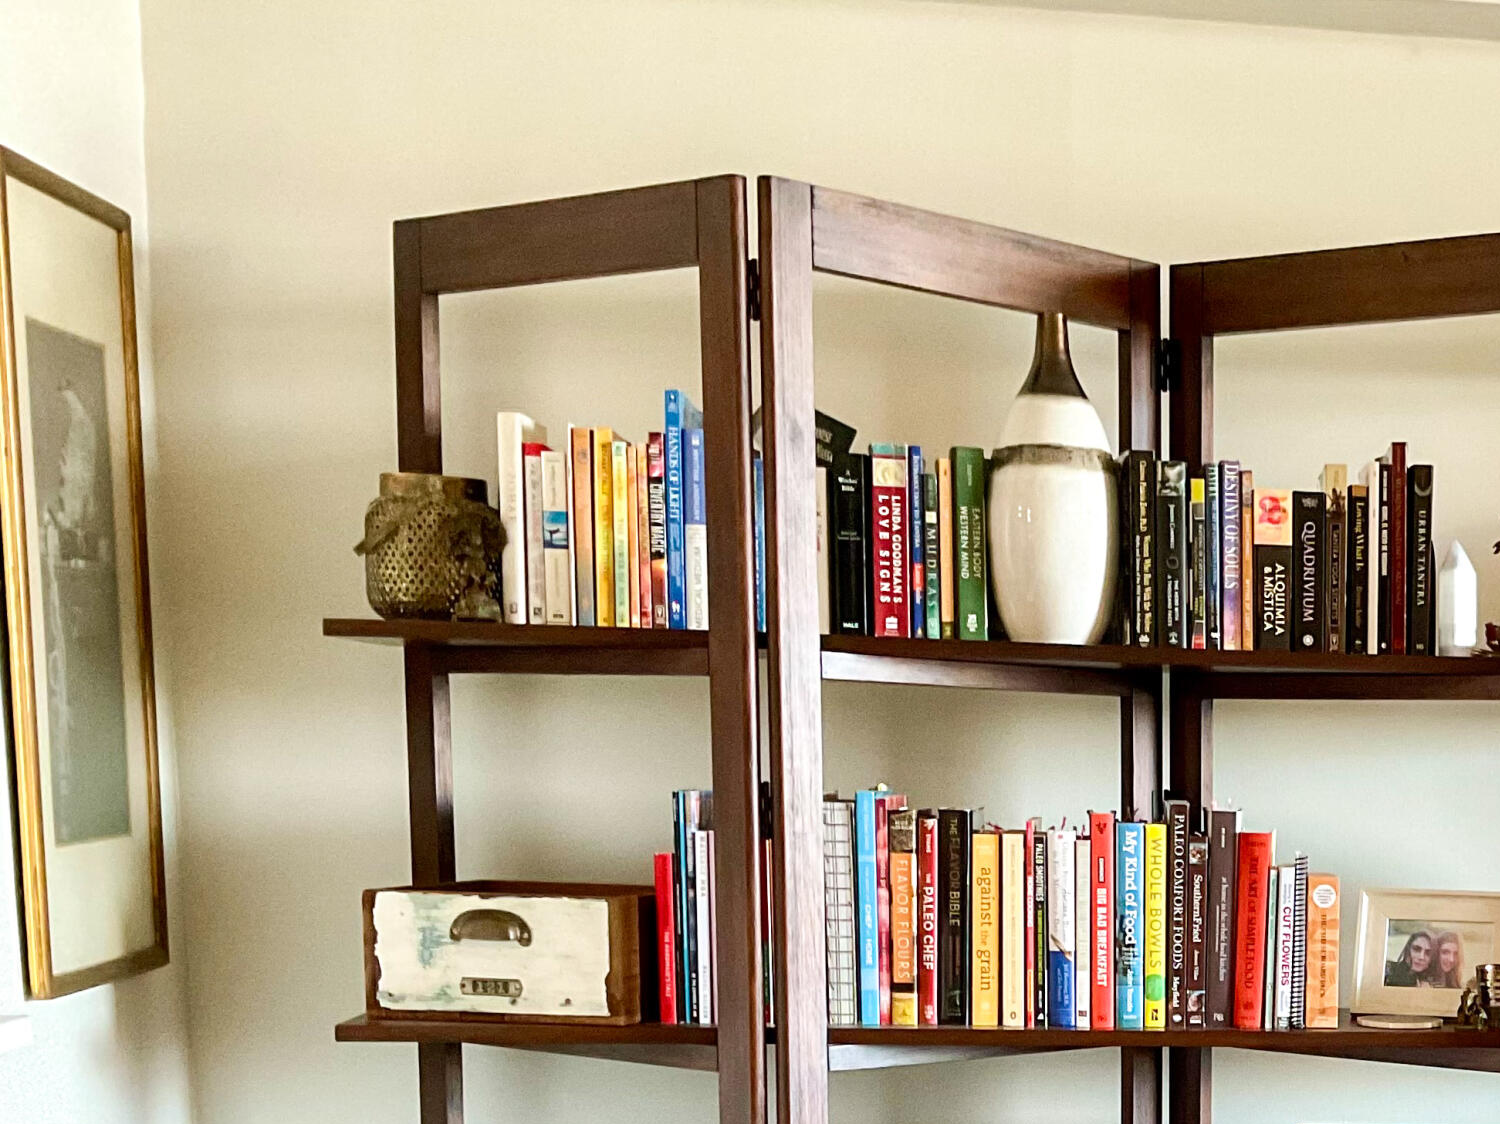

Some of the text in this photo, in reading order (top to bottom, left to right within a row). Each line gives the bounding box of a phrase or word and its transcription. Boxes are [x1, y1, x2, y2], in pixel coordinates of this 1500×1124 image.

[668, 426, 681, 468] HANDS
[669, 470, 681, 485] OF
[669, 487, 681, 522] LIGHT
[650, 483, 665, 553] COVENTRY MAGIC
[891, 495, 901, 531] LINDA
[1224, 463, 1240, 589] DESTINY OF SOULS
[1354, 502, 1365, 572] Loving What Is
[878, 494, 891, 604] LOVE SIGNS
[926, 527, 937, 609] MUDRAS
[959, 506, 970, 580] WESTERN MIND
[972, 507, 982, 578] EASTERN BODY
[1416, 510, 1426, 606] URBAN TANTRA
[1273, 562, 1286, 635] ALQUIMIA
[1301, 521, 1316, 622] QUADRIVIUM
[695, 587, 704, 629] MEDICAL
[1263, 576, 1275, 632] MÍSTICA
[949, 818, 958, 835] THE
[1035, 843, 1044, 864] PALEO
[1174, 814, 1186, 856] PALEO
[949, 837, 960, 890] FLAVOR
[1035, 865, 1044, 902] SMOOTHIES
[1122, 830, 1138, 945] My Kind of Food
[1172, 859, 1185, 922] COMFORT
[864, 904, 873, 928] CHEF
[896, 860, 911, 979] FLAVOR FLOURS
[922, 886, 934, 931] PALEO
[949, 891, 960, 926] BIBLE
[1096, 887, 1107, 906] BIG
[1096, 906, 1107, 928] BAD
[1149, 838, 1162, 968] WHOLE BOWLS
[1245, 857, 1259, 989] THE ART OF SIMPLE FOOD
[1282, 906, 1292, 929] CUT
[865, 938, 873, 966] HOME
[922, 935, 934, 970] CHEF
[976, 867, 995, 991] against the grain
[1172, 926, 1184, 970] FOODS
[1097, 930, 1107, 987] BREAKFAST
[1281, 932, 1292, 987] FLOWERS
